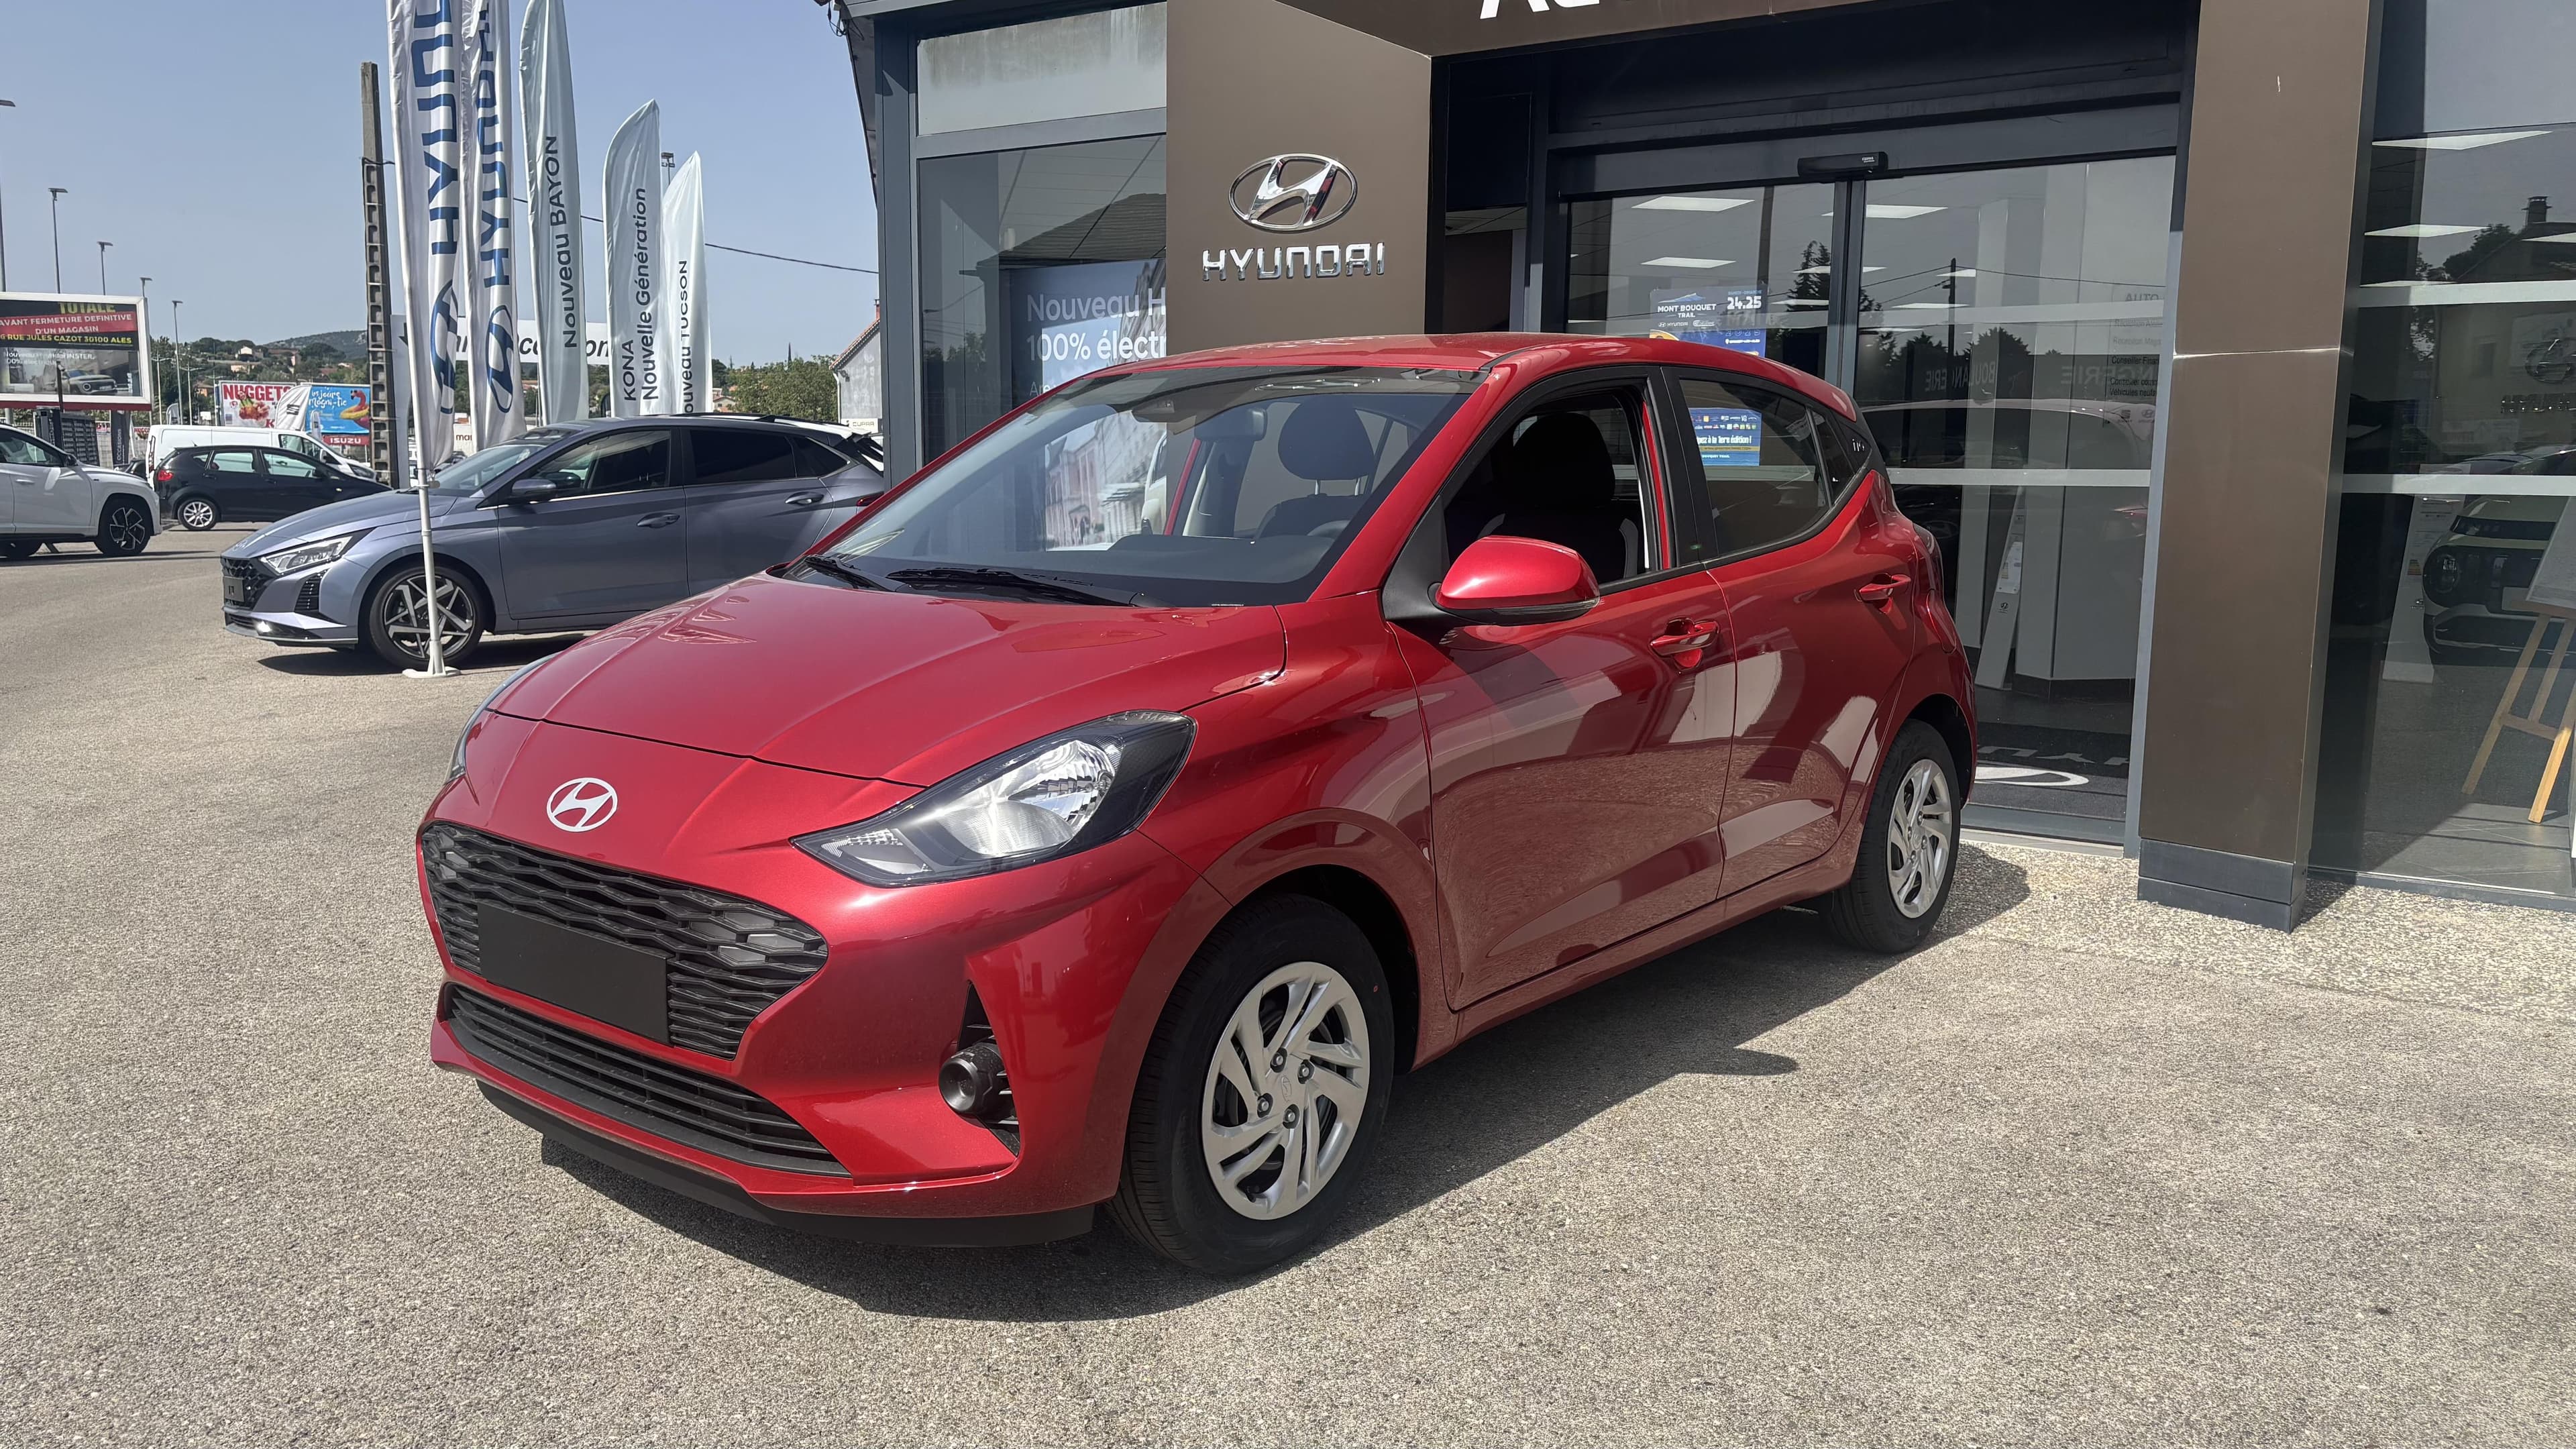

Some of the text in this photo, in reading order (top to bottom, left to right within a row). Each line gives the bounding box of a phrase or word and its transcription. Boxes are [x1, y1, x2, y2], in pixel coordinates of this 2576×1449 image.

[545, 136, 578, 348] Nouveau BAYON
[1201, 242, 1385, 282] HYUNDAI
[633, 186, 659, 400] Nouvelle Génération
[1026, 291, 1140, 322] Nouveau
[1680, 303, 1717, 312] BOUQUET
[1727, 295, 1762, 310] 24.25
[0, 314, 132, 326] AVANT FERMETURE DEFINITIVE
[58, 325, 99, 333] MAGASIN
[678, 260, 695, 413] ouveau TUCSON
[1026, 333, 1091, 362] 100%
[621, 339, 637, 401] KONA
